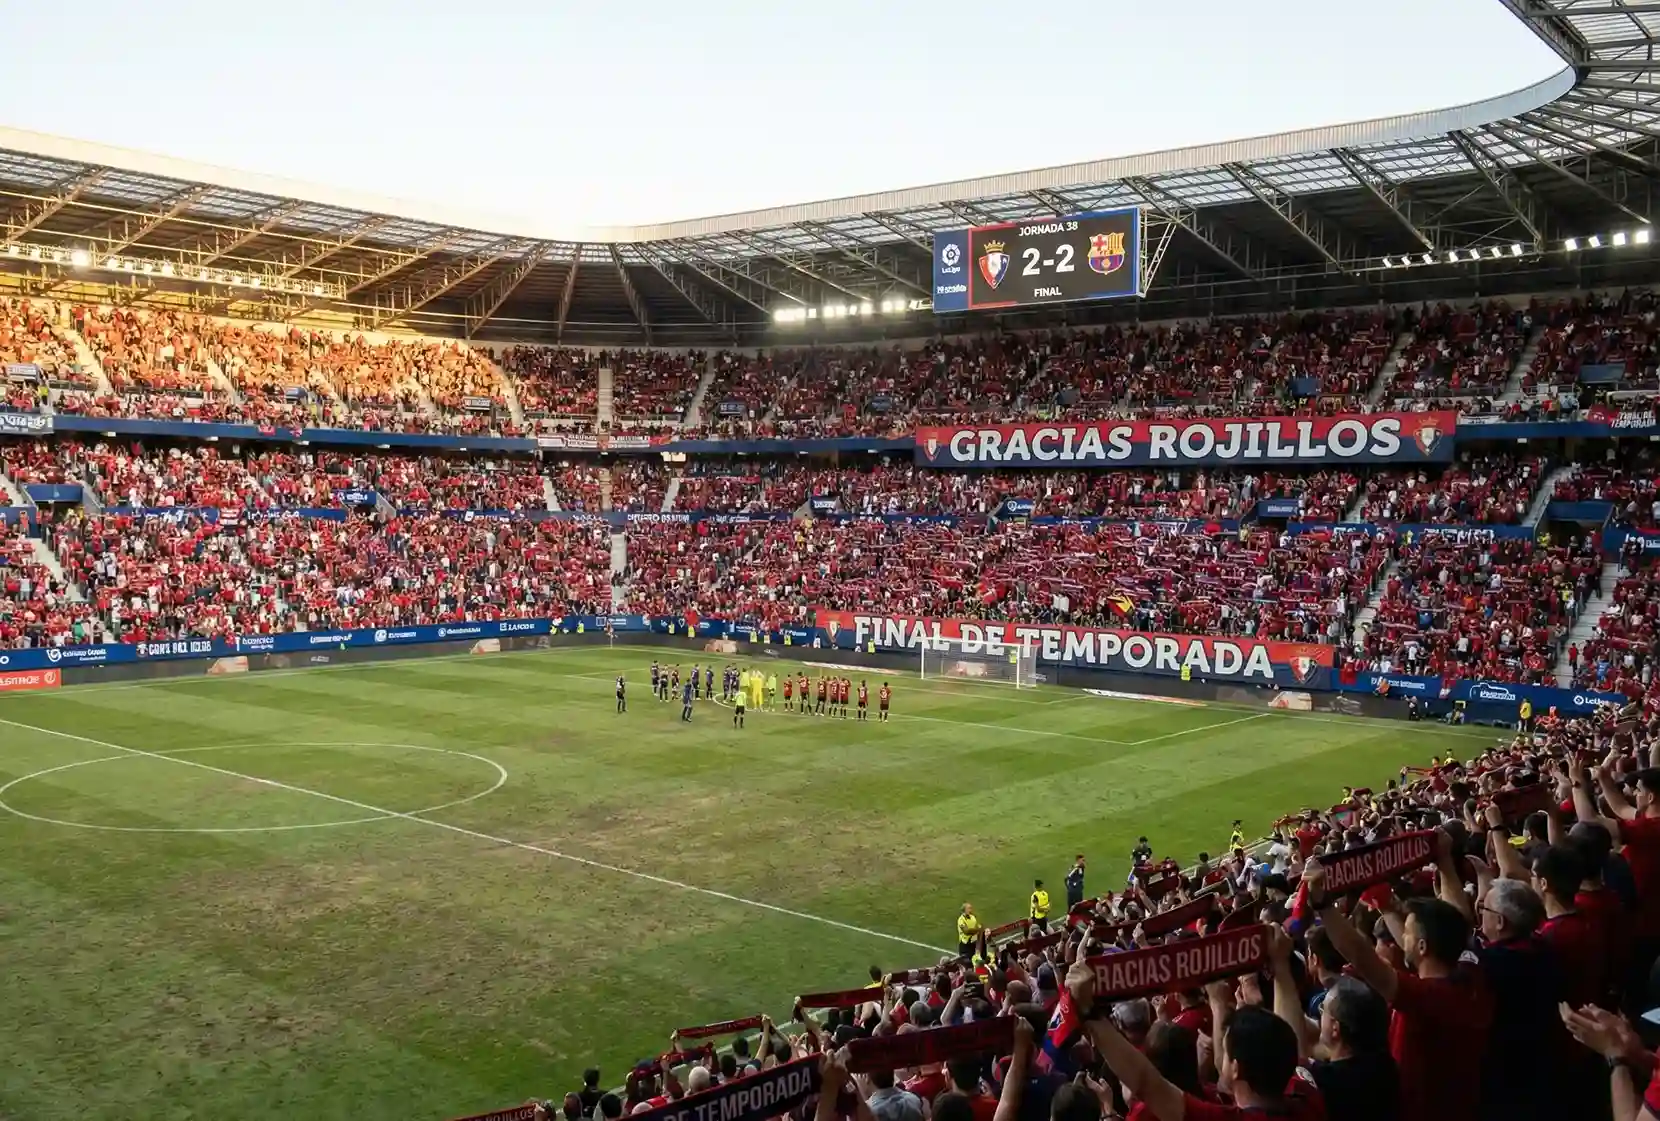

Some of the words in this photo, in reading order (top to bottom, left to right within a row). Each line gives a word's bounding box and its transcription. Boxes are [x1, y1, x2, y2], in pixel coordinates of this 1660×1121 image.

[1019, 222, 1065, 237] JORNADA
[1066, 221, 1079, 231] 38
[1022, 244, 1076, 277] 2-2
[1034, 286, 1062, 298] FINAL
[950, 426, 1134, 463] GRACIAS
[1149, 418, 1401, 460] ROJILLOS
[855, 617, 949, 650] FINAL
[960, 624, 1005, 655] DE
[1016, 628, 1273, 678] TEMPORADA
[1322, 852, 1375, 892] RACIAS
[1376, 836, 1431, 874] ROJILLOS
[1093, 954, 1171, 993] RACIAS
[1176, 933, 1262, 979] ROJILLOS
[695, 1067, 812, 1121] TEMPORADA
